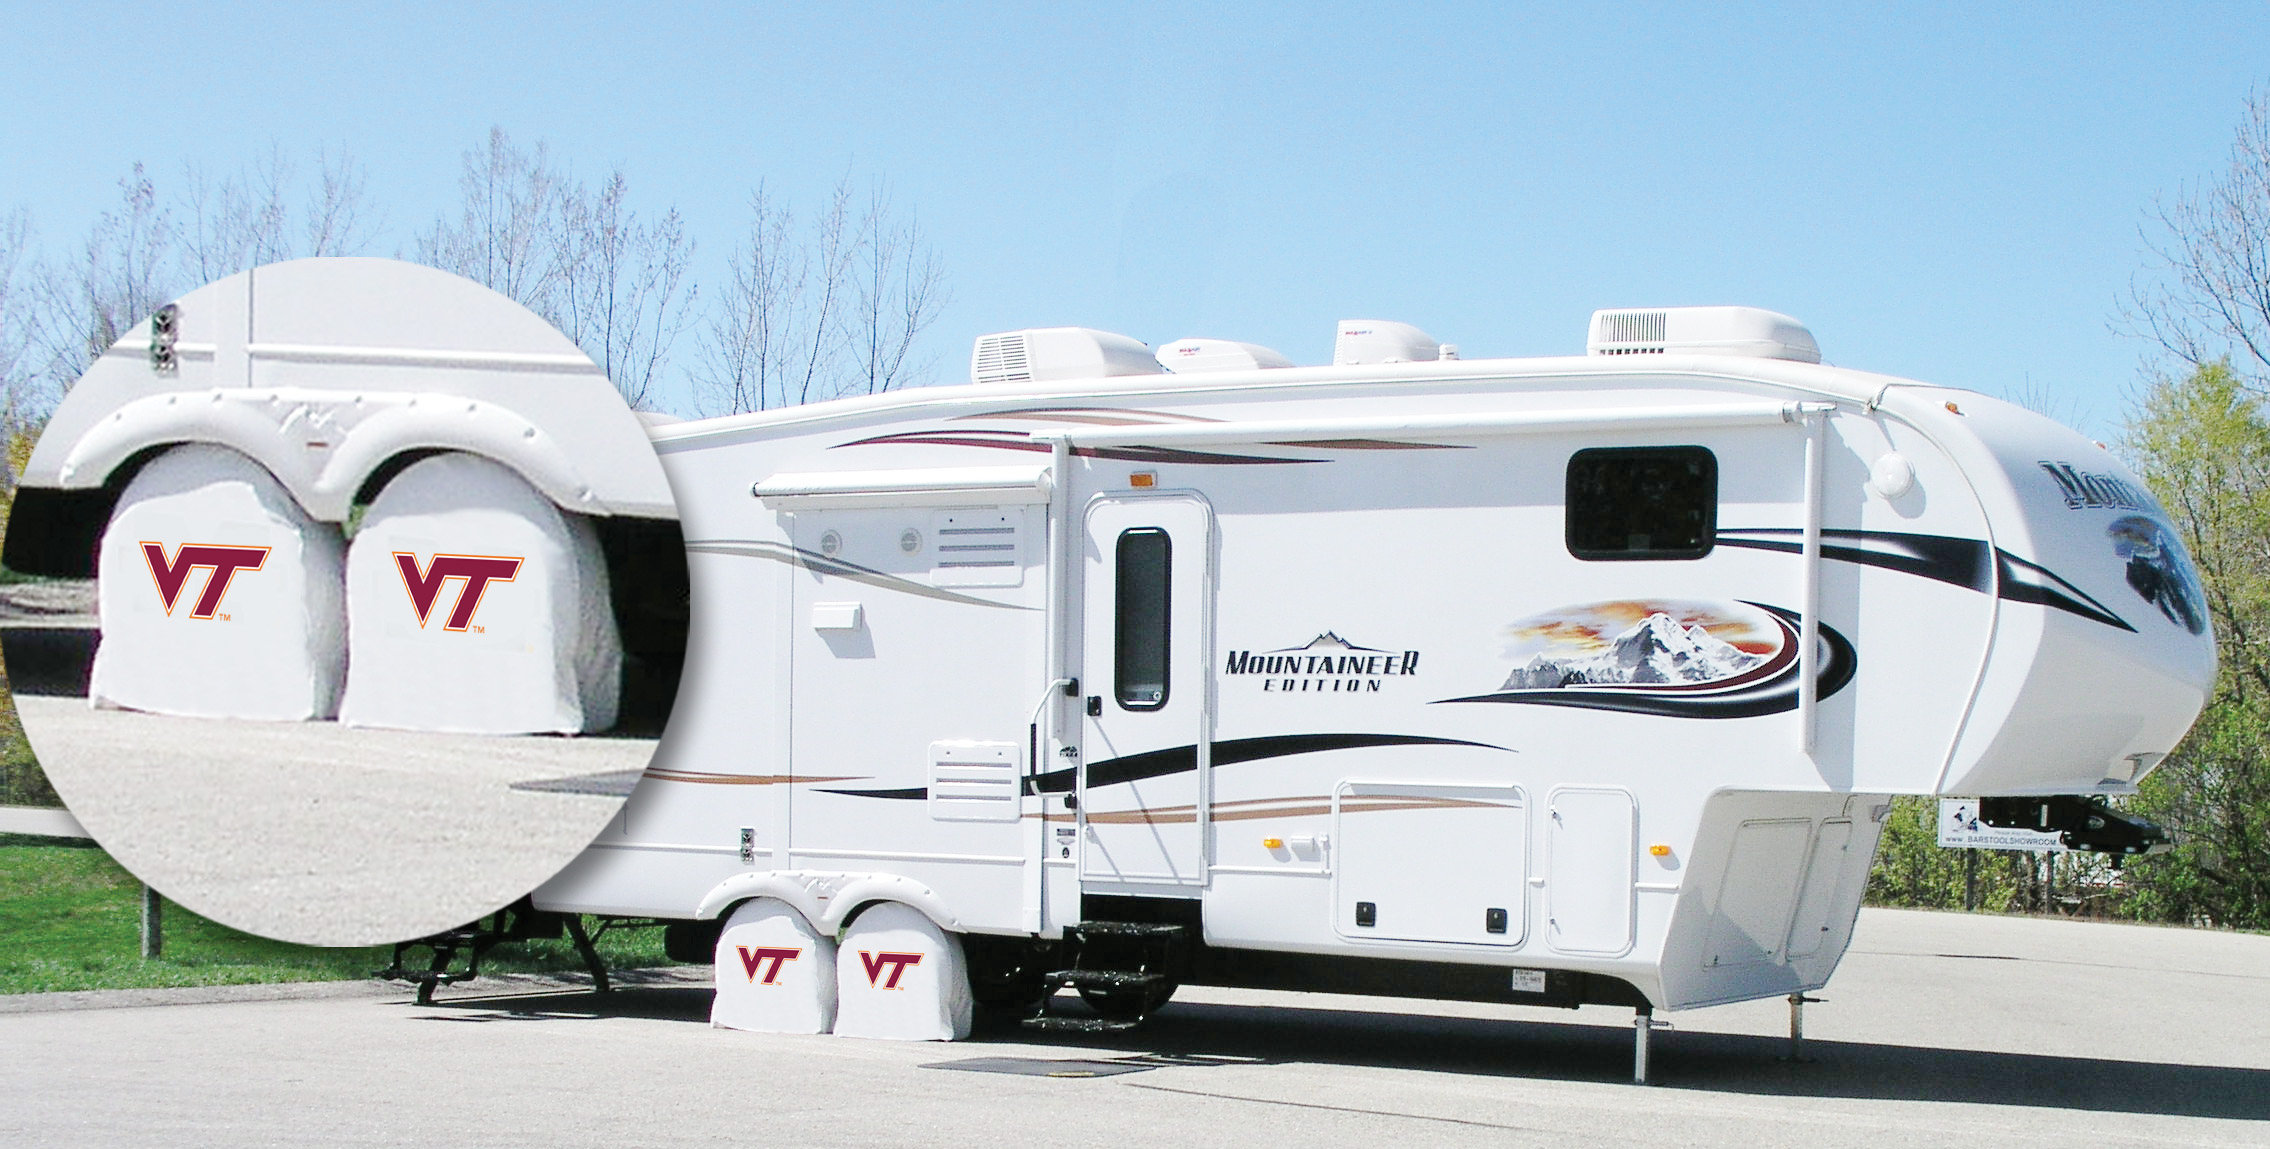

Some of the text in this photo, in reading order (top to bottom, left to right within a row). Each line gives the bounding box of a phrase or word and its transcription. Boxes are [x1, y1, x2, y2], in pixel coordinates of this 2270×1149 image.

[139, 540, 272, 620] VT
[392, 551, 525, 632] VT
[1225, 650, 1419, 676] MOUNTAINEER
[1263, 678, 1382, 693] EDITION
[735, 945, 803, 985] VT
[857, 950, 925, 990] VT
